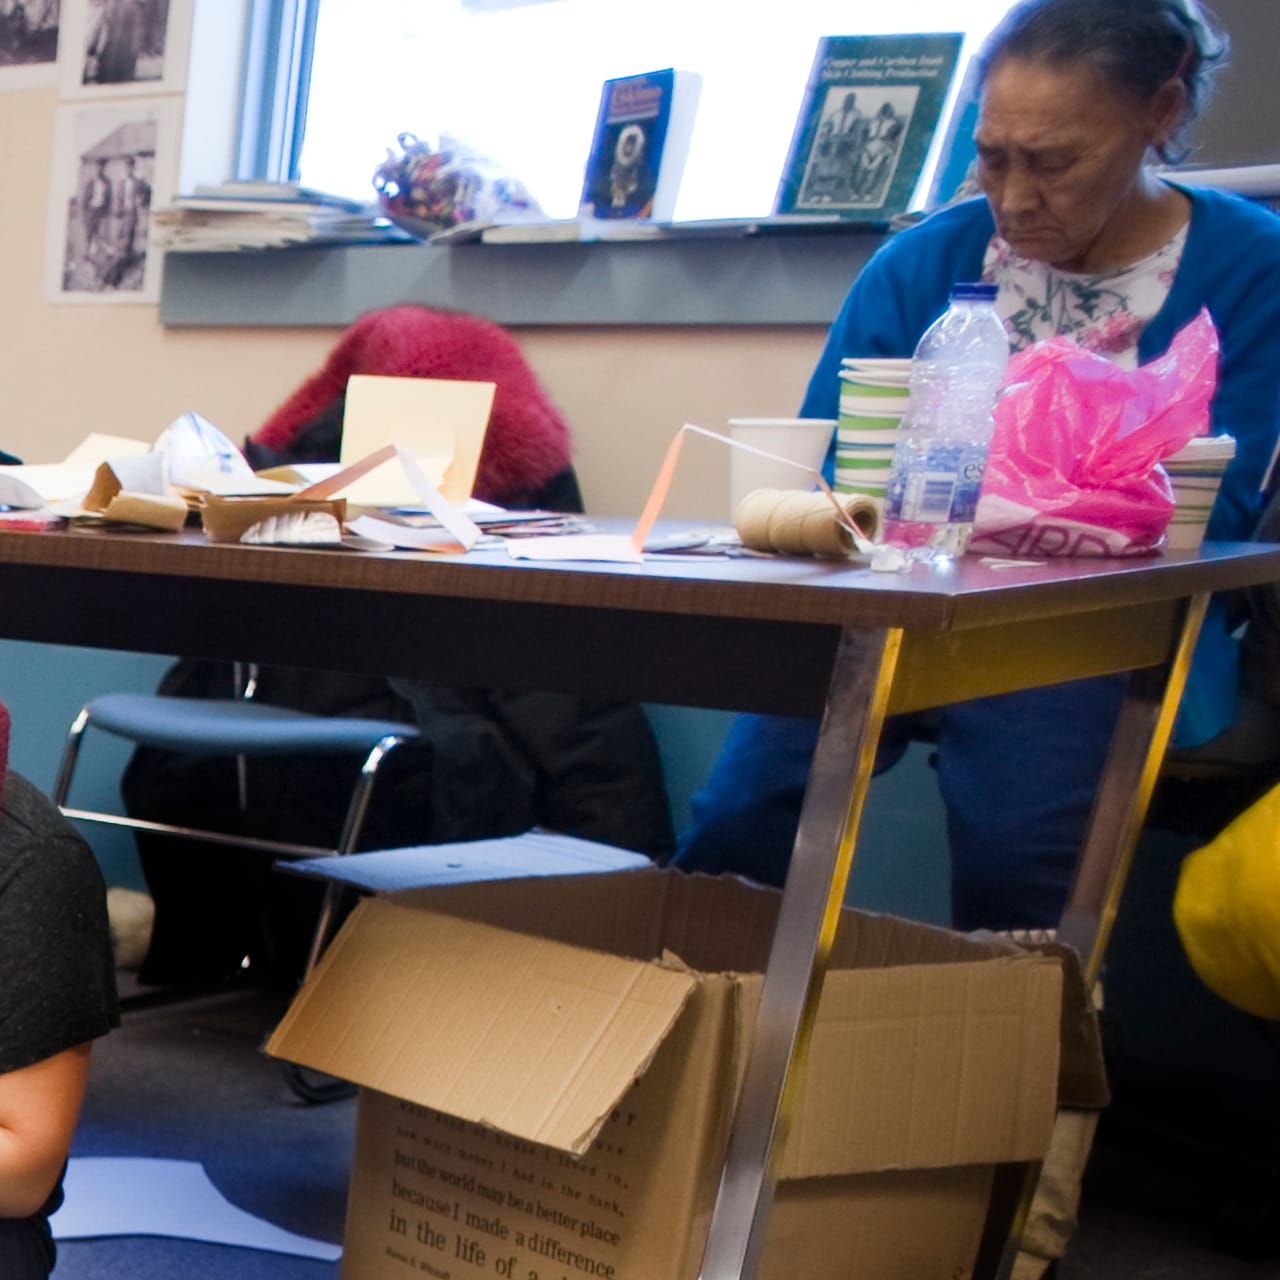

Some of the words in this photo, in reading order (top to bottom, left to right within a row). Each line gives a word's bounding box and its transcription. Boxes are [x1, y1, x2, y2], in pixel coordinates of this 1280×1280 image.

[389, 1208, 408, 1236] in
[416, 1220, 447, 1251] the
[455, 1234, 487, 1267] life
[495, 1255, 518, 1280] of
[391, 1178, 452, 1214] because
[452, 1202, 460, 1222] I
[465, 1209, 509, 1240] made
[515, 1231, 525, 1247] a
[527, 1233, 616, 1280] difference
[394, 1149, 416, 1170] but
[416, 1157, 437, 1178] the
[439, 1169, 475, 1193] world
[477, 1182, 505, 1206] may
[507, 1189, 525, 1210] be
[525, 1201, 534, 1214] a
[535, 1200, 579, 1230] better
[579, 1217, 621, 1246] place
